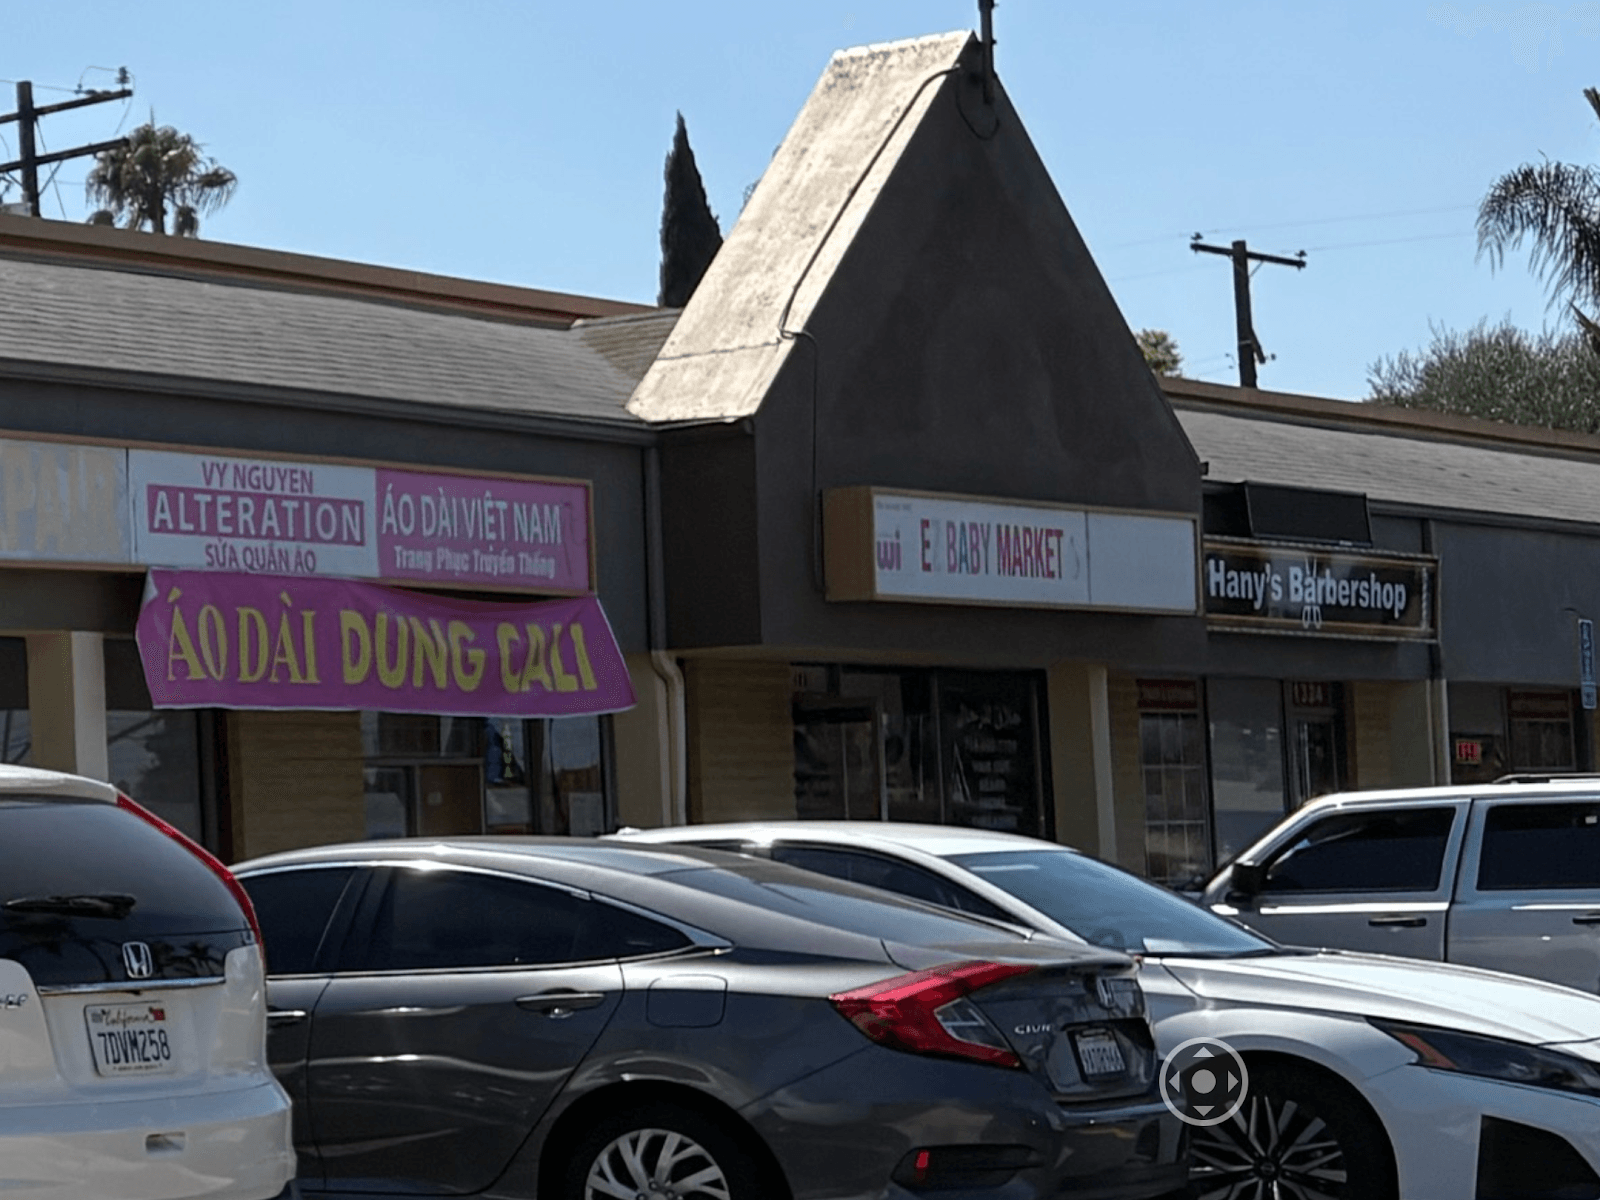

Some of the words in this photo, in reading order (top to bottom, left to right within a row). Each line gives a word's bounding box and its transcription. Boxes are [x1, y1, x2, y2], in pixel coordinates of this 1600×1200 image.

[201, 460, 228, 488] VY
[233, 463, 314, 494] NGUYEN
[153, 490, 362, 542] ALTERATION
[381, 482, 415, 536] ÁO
[419, 486, 458, 539] DÀI
[512, 501, 562, 545] NAM
[393, 545, 433, 573] Trang
[945, 520, 991, 576] BABY
[996, 523, 1064, 580] MARKET
[1207, 558, 1283, 611] Hany's
[1289, 566, 1407, 619] Barbershop
[166, 586, 228, 682] ÁO
[235, 591, 322, 685] DÀI
[340, 609, 486, 691] DUNG
[497, 619, 598, 693] CALI
[96, 1029, 171, 1065] 7DVM258
